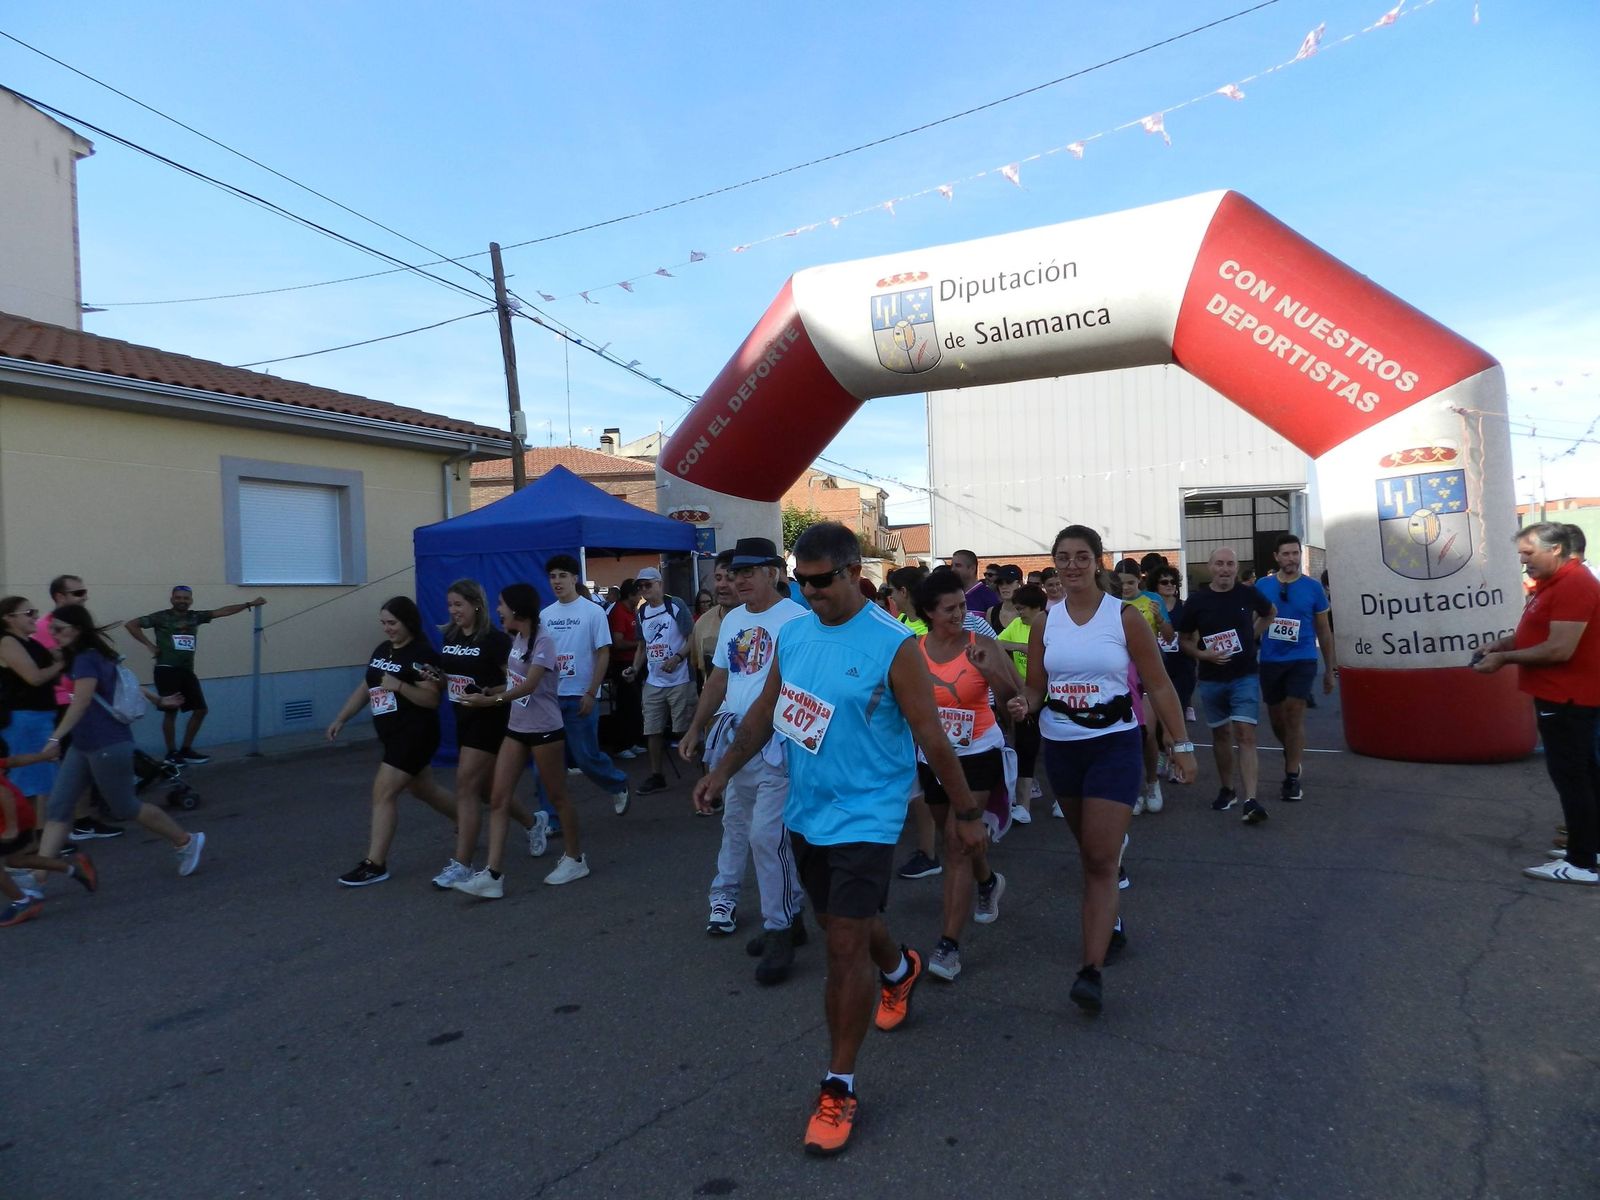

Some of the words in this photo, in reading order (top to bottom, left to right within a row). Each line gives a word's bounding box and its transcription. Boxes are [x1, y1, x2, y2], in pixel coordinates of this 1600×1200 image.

[940, 258, 1077, 303] Diputación
[944, 331, 966, 350] de
[974, 306, 1111, 345] Salamanca
[1218, 259, 1276, 304] CON
[1273, 295, 1419, 392] NUESTROS
[1205, 293, 1380, 413] DEPORTISTAS
[676, 436, 710, 475] CON
[708, 414, 731, 439] EL
[727, 324, 800, 413] DEPORTE
[1360, 584, 1503, 620] Diputación
[1274, 625, 1294, 636] 486
[442, 645, 480, 657] adidas
[650, 650, 664, 658] 435
[1355, 637, 1373, 655] de
[1050, 683, 1099, 693] bedunia
[781, 683, 831, 720] bedunia
[1060, 694, 1089, 710] 06
[782, 703, 816, 732] 407
[939, 709, 974, 722] dunia
[942, 721, 962, 737] 93
